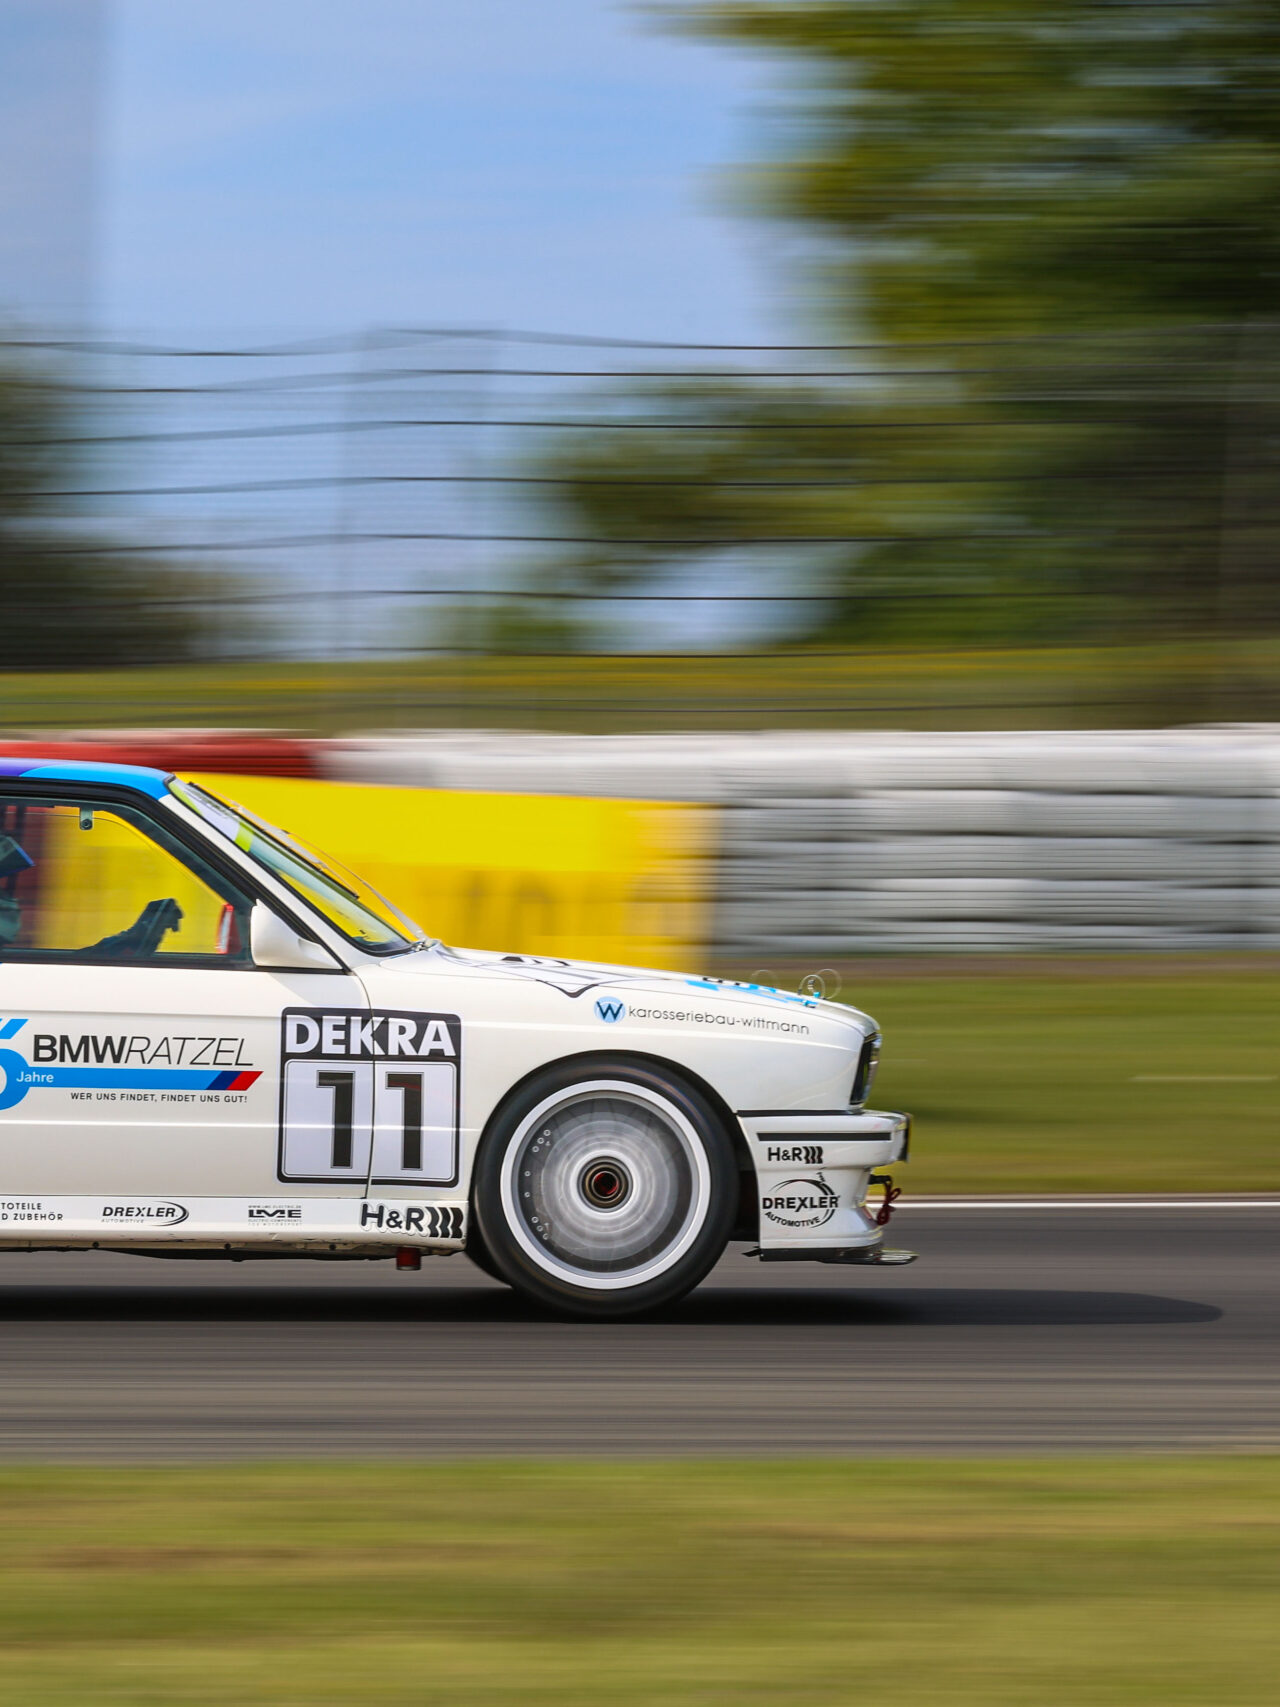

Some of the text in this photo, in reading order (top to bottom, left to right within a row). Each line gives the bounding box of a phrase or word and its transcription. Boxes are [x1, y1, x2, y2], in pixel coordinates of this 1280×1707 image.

[628, 1005, 810, 1035] karosseriebau-wittmann
[285, 1014, 457, 1057] DEKRA
[15, 1070, 54, 1084] Jahre
[70, 1092, 248, 1104] WER UNS FINDET, FINDET UNS GUT!
[316, 1070, 425, 1171] 11
[767, 1146, 803, 1162] H&R
[102, 1206, 176, 1218] DREXLER
[762, 1197, 839, 1213] DREXLER
[13, 1211, 64, 1221] ZUBEHÖR
[360, 1203, 426, 1233] H&R
[764, 1211, 820, 1228] AUTOMOTIVE
